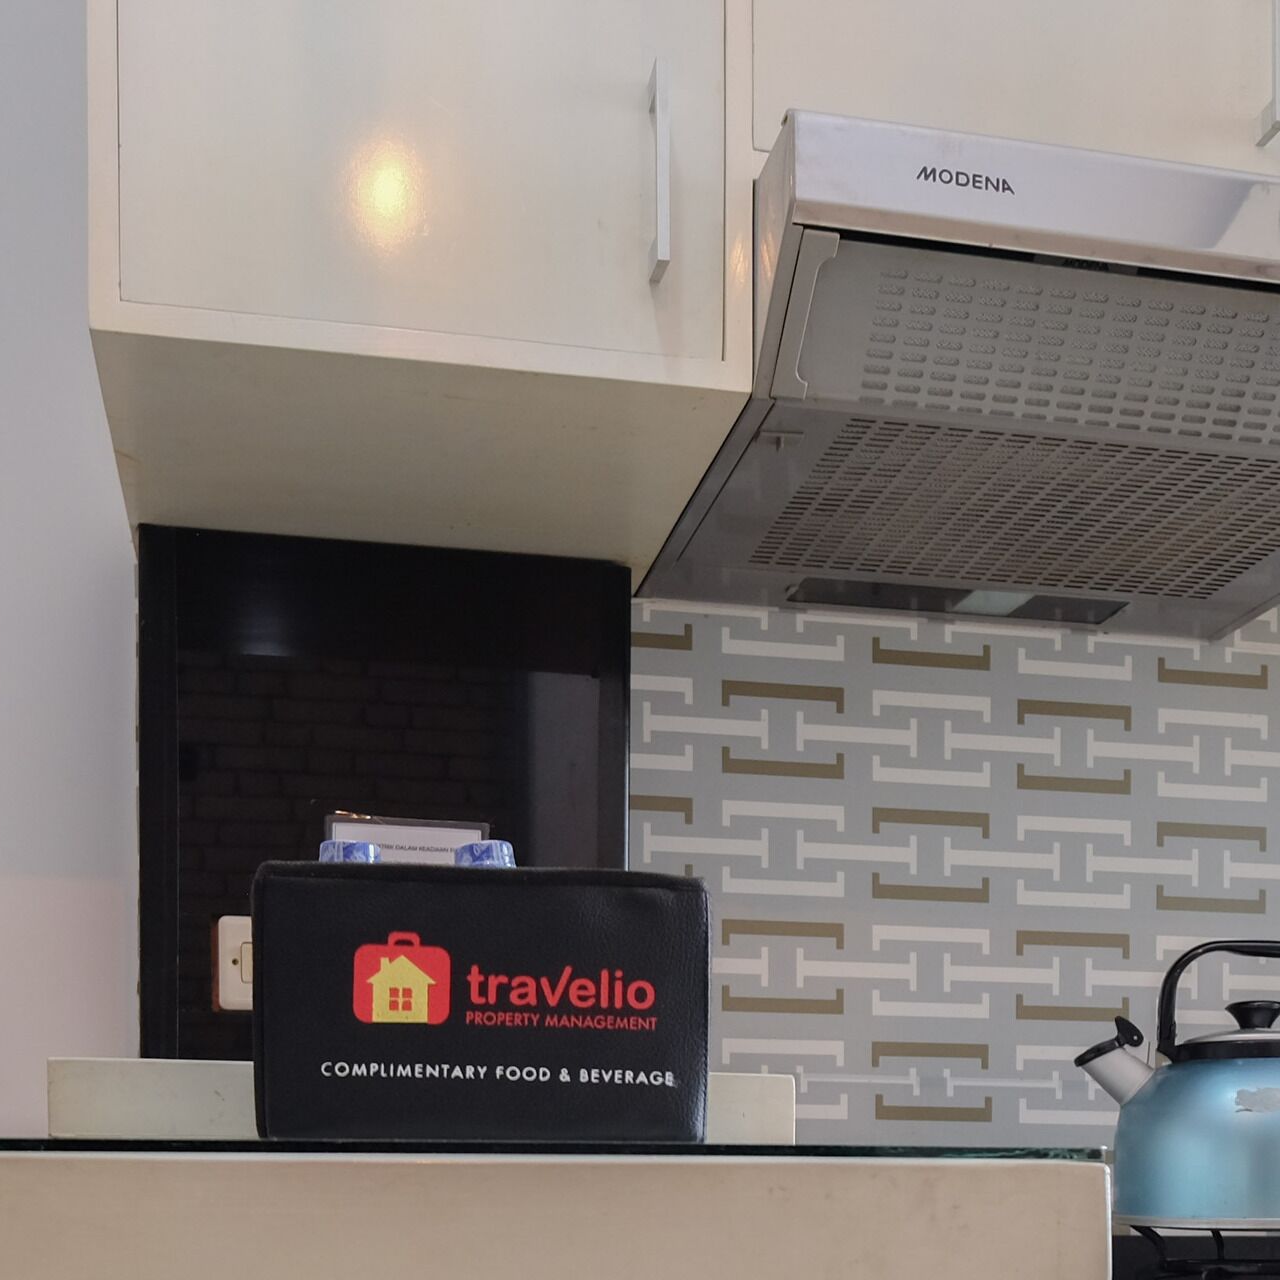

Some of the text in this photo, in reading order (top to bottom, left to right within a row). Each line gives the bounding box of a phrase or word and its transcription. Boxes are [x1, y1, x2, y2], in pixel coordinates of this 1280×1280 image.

[916, 165, 1016, 196] MODENA
[466, 964, 657, 1010] travelio
[465, 1010, 658, 1032] PROPERTY MANAGEMENT
[320, 1061, 676, 1088] COMPLIMENTARY FOOD & BEVERAGE
